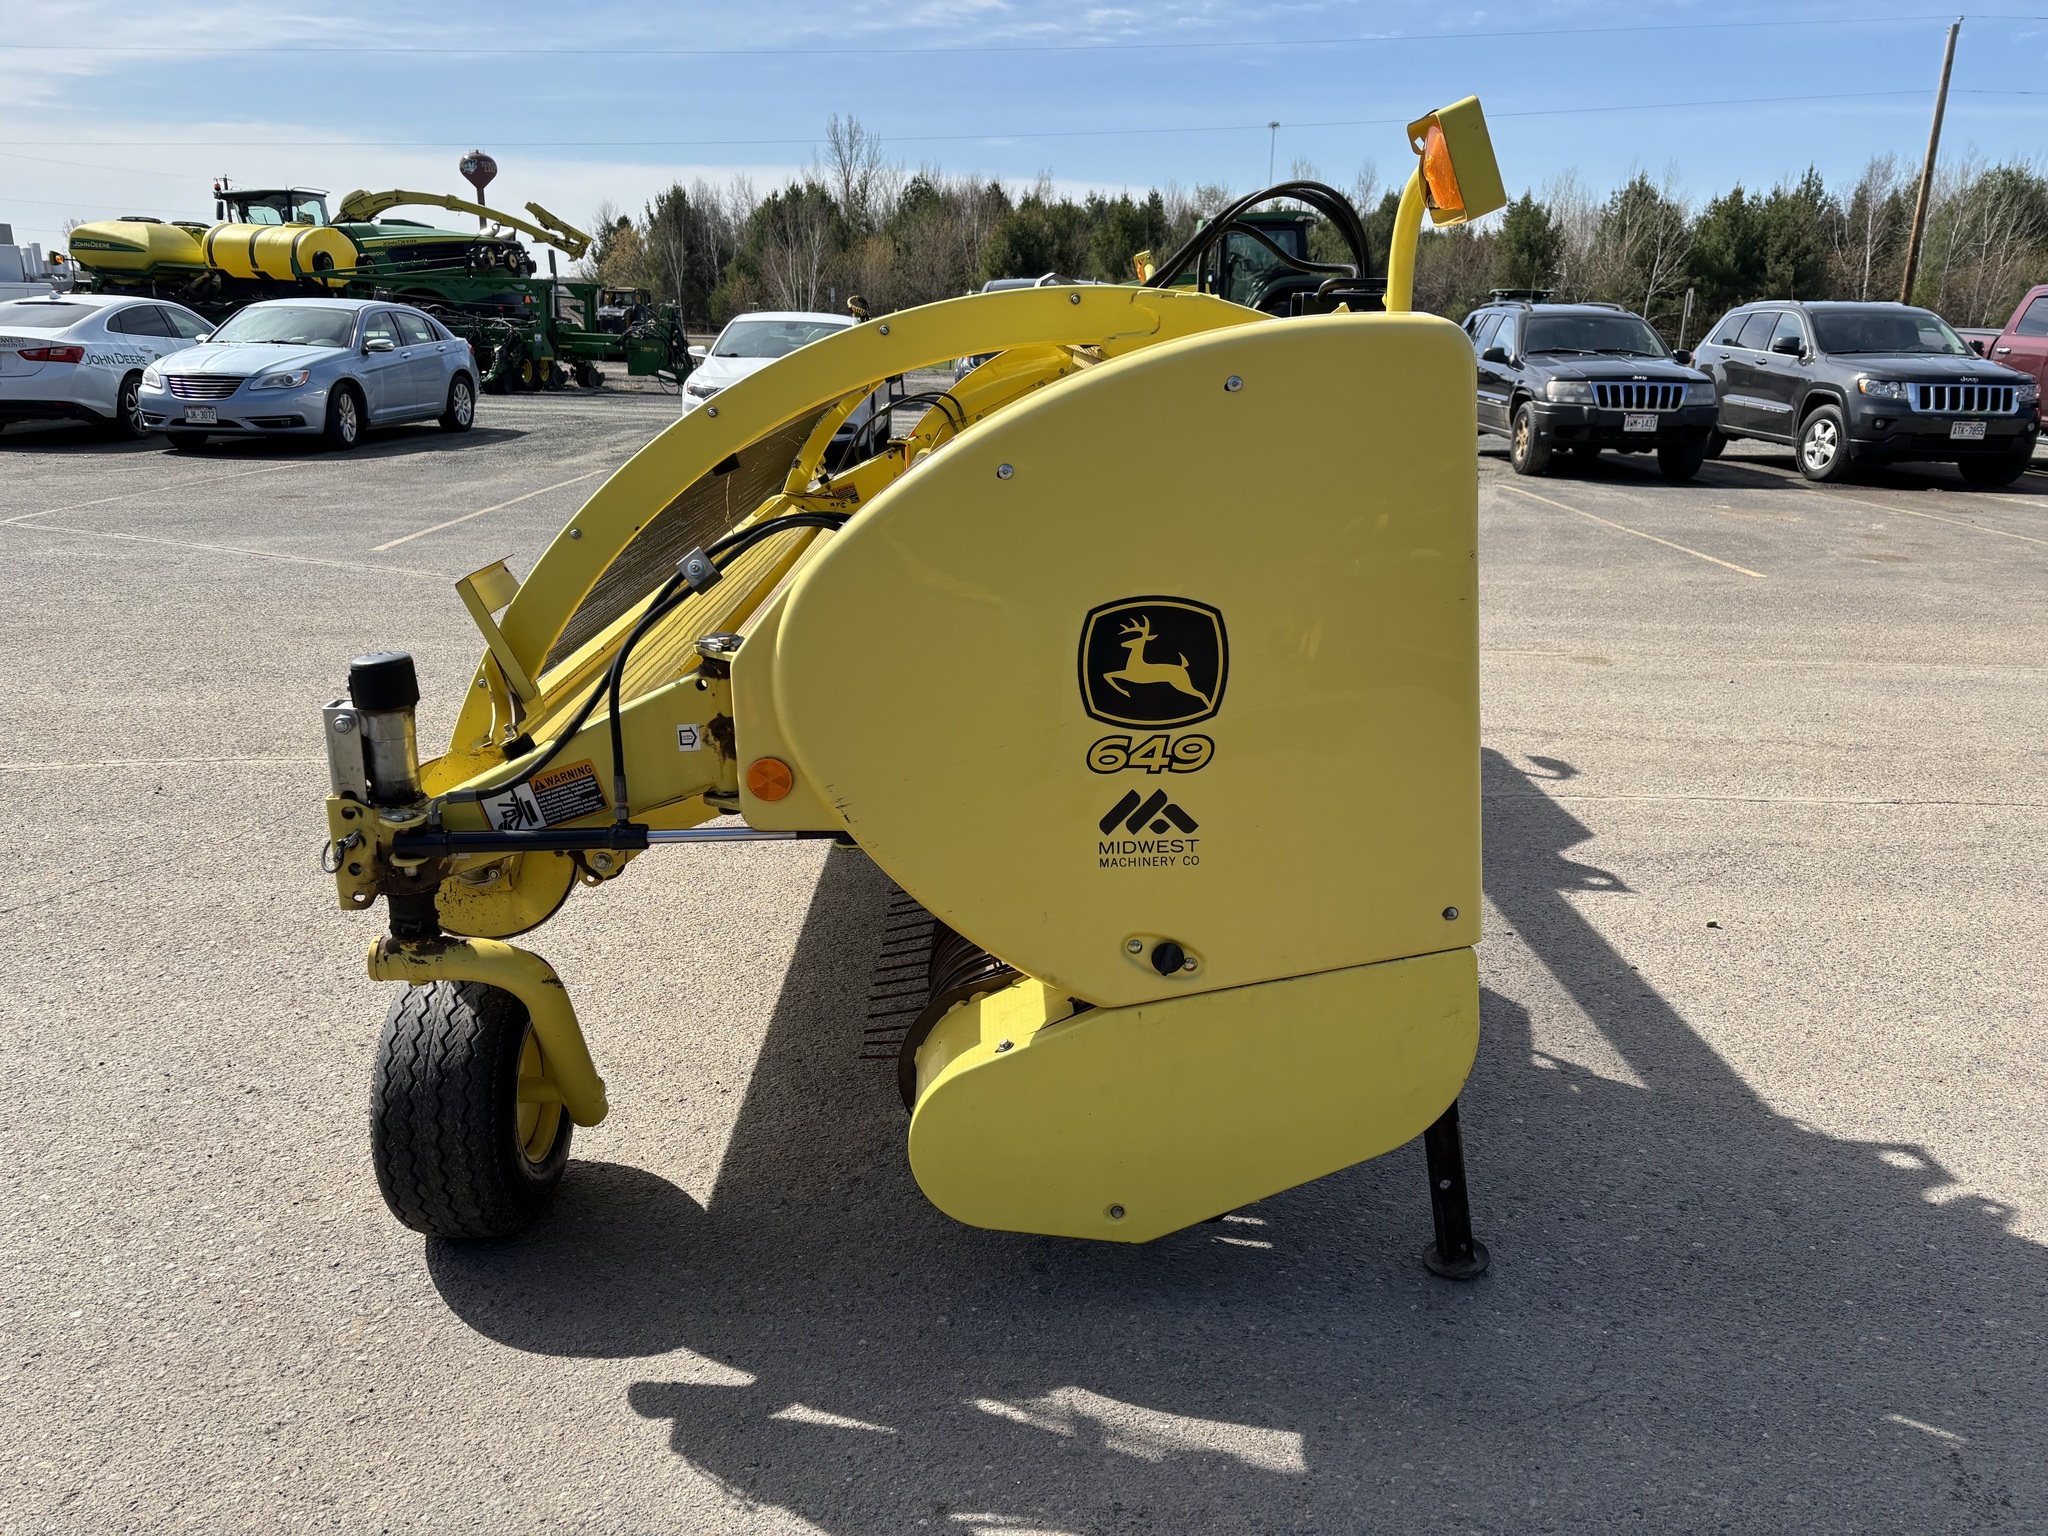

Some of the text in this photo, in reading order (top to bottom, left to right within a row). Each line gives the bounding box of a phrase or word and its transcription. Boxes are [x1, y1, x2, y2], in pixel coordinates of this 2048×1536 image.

[90, 241, 110, 249] DEERE
[86, 352, 147, 365] JOHN DEERE
[1086, 734, 1215, 775] 649
[544, 764, 592, 786] WARNING
[1098, 838, 1200, 855] MIDWEST
[1099, 855, 1200, 868] MACHINERY CO
